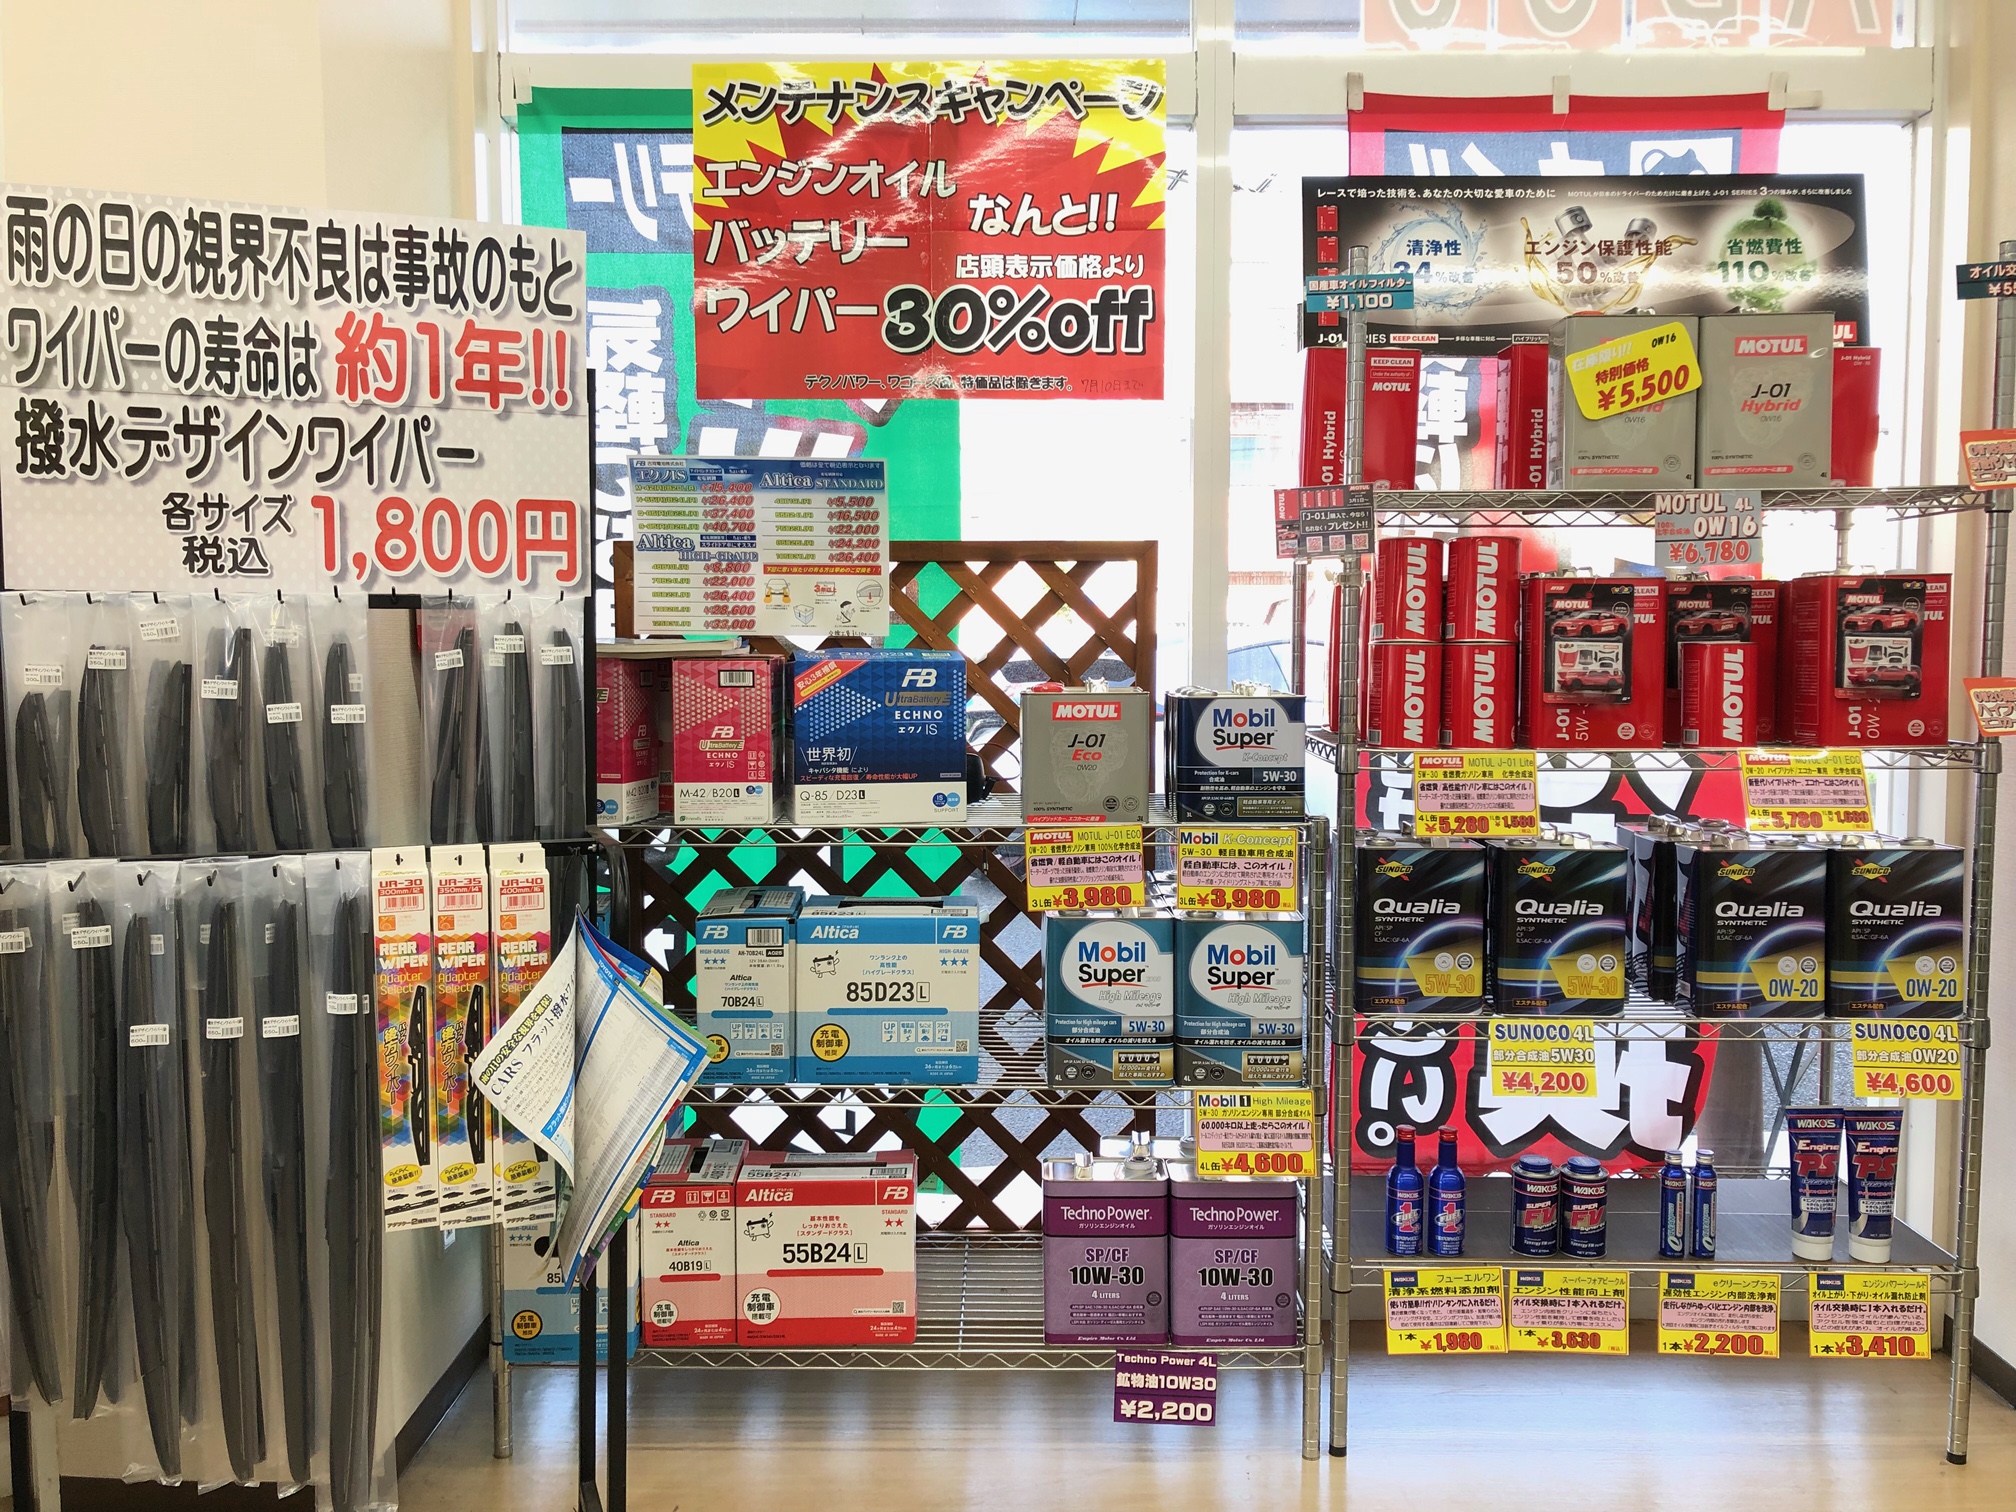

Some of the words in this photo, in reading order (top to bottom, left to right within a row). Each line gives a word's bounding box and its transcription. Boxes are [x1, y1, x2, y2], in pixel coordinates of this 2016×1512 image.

[702, 78, 1163, 125] メンテナンスキャンペーン
[703, 161, 955, 197] エンジンオイル
[1318, 188, 1556, 198] レースで培った技術を、あなたの大切な愛車のために
[968, 195, 1117, 236] なんと!!
[705, 219, 909, 265] バッテリー
[1407, 240, 1461, 256] 清浄性
[1525, 240, 1671, 256] エンジン保護性能
[1727, 239, 1802, 254] 省燃費性
[6, 195, 574, 317] 雨の日の視界不良は事故のもと
[956, 255, 1145, 279] 店頭表示価格より
[1326, 294, 1393, 310] ¥1,100
[704, 289, 879, 334] ワイパー
[884, 285, 1154, 354] 30%off
[1737, 339, 1804, 354] MOTUL
[7, 305, 319, 398] ワイパーの寿命は
[335, 312, 570, 409] 約1年!!
[1595, 358, 1649, 386] 特別価格
[1372, 383, 1411, 391] MOTUL
[1597, 365, 1689, 411] ¥5,500
[1751, 383, 1791, 398] J-01
[1741, 399, 1801, 413] Hybrid
[15, 397, 477, 485] 撥水デザインワイパー
[759, 472, 813, 489] Altica
[1656, 493, 1726, 514] MOTUL
[1735, 498, 1753, 511] 4L
[1694, 515, 1757, 538] 0W16
[162, 493, 293, 533] 各サイズ
[311, 495, 577, 582] 1,800円
[636, 534, 695, 551] Altica
[183, 539, 269, 575] 税込
[1670, 541, 1750, 564] ¥6,780
[1406, 542, 1427, 634] MOTUL
[1476, 542, 1498, 634] MOTUL
[1554, 600, 1589, 608] MOTUL
[1678, 601, 1710, 609] MOTUL
[902, 668, 937, 687] FB
[1404, 650, 1426, 743] MOTUL
[1473, 650, 1495, 743] MOTUL
[895, 710, 943, 719] ECHNO
[1213, 708, 1275, 728] Mobil
[711, 726, 734, 738] FB
[1213, 729, 1274, 749] Super
[1068, 734, 1106, 748] J-01
[807, 747, 851, 762] 世界初
[1072, 749, 1103, 761] Eco
[1262, 771, 1297, 782] 5W-30
[1425, 816, 1489, 835] ¥5,280
[1181, 832, 1218, 844] Mobil
[1223, 834, 1293, 846] K-Concept
[1376, 865, 1413, 874] SUNOCO
[1518, 866, 1555, 874] SUNOCO
[1718, 868, 1755, 876] SUNOCO
[1853, 867, 1890, 875] SUNOCO
[379, 879, 423, 888] UR-30
[439, 878, 482, 886] UR-35
[502, 878, 544, 886] UR-40
[1052, 886, 1131, 908] ¥3,980
[1197, 889, 1280, 909] ¥3,980
[1373, 899, 1461, 914] Qualia
[1515, 899, 1604, 915] Qualia
[1715, 901, 1804, 917] Qualia
[703, 925, 729, 939] FB
[810, 926, 859, 939] Altica
[942, 925, 968, 939] FB
[379, 941, 417, 956] REAR
[1079, 942, 1146, 962] Mobil
[1208, 945, 1275, 965] Mobil
[379, 954, 428, 969] WIPER
[380, 971, 423, 983] Adapter
[1078, 964, 1146, 986] Super
[1207, 966, 1275, 989] Super
[380, 983, 413, 995] Select
[1425, 974, 1475, 993] 5W-30
[1567, 975, 1618, 996] 5W-30
[1769, 979, 1818, 998] 0W-20
[1906, 979, 1957, 998] 0W-20
[1099, 991, 1120, 1001] High
[1121, 991, 1162, 1002] Mileage
[820, 1030, 840, 1039] 充電
[1128, 1020, 1165, 1033] 5W-30
[1258, 1023, 1295, 1035] 5W-30
[1573, 1026, 1594, 1041] 4L
[1934, 1026, 1956, 1041] 4L
[815, 1039, 844, 1048] 制御車
[491, 1058, 523, 1096] CARS
[1502, 1072, 1586, 1094] ¥4,200
[1866, 1072, 1951, 1095] ¥4,600
[1198, 1095, 1236, 1107] Mobil
[1798, 1140, 1839, 1151] Engine
[1221, 1153, 1303, 1174] ¥4,600
[745, 1190, 794, 1202] Altica
[1085, 1248, 1130, 1262] SP/CF
[1069, 1266, 1145, 1286] 10W-30
[1198, 1267, 1274, 1287] 10W-30
[1092, 1290, 1098, 1299] 4
[1513, 1288, 1625, 1297] エンジン性能向上剤
[654, 1310, 674, 1318] 制御車
[1420, 1332, 1482, 1352] ¥1,980
[1537, 1331, 1600, 1349] ¥3,630
[1684, 1333, 1763, 1354] ¥2,200
[1835, 1335, 1915, 1357] ¥3,410
[1117, 1353, 1157, 1364] Techno
[1161, 1356, 1195, 1366] Power
[1199, 1356, 1217, 1367] 4L
[1120, 1400, 1212, 1421] ¥2,200
